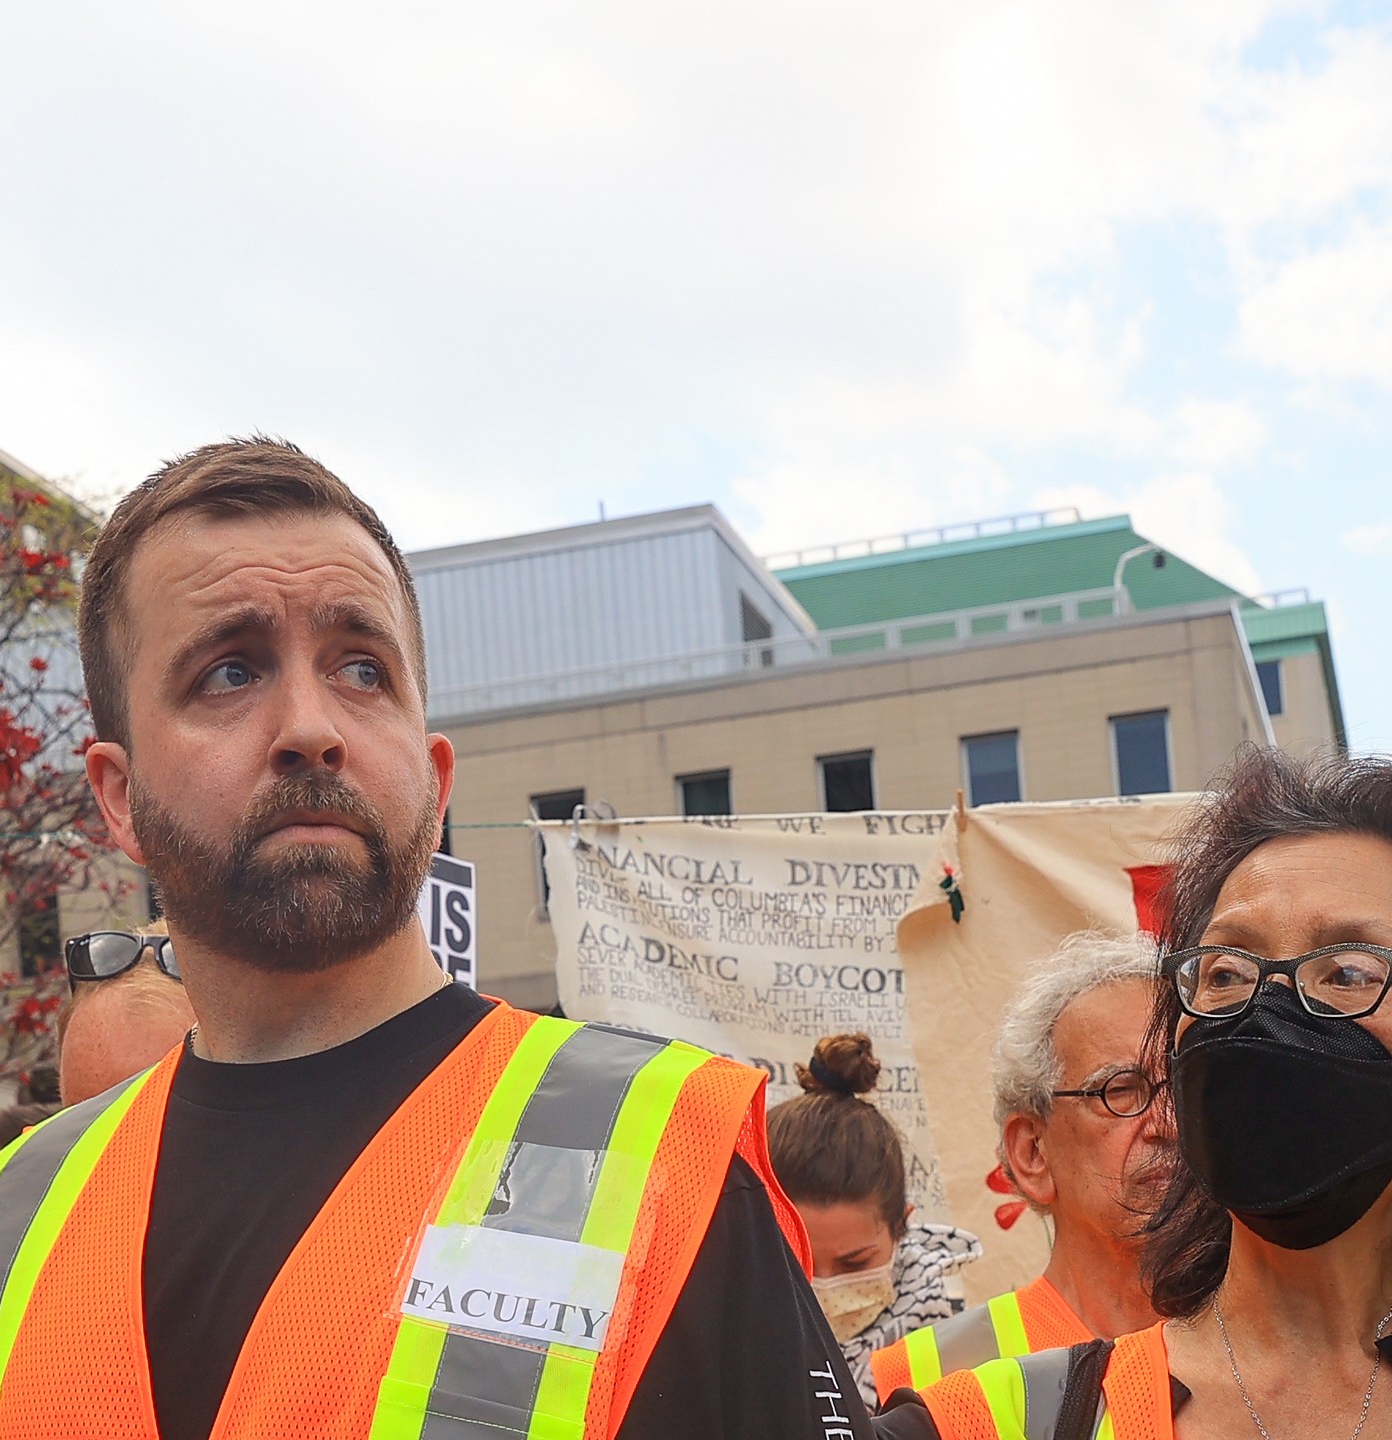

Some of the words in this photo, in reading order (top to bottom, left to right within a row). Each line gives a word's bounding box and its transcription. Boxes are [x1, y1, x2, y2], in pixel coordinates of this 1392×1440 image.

[775, 816, 826, 835] WE
[863, 813, 948, 836] FIGH
[587, 843, 752, 886] NANCIAL
[604, 882, 711, 923] INSUTIONS
[719, 909, 754, 928] THAT
[761, 911, 825, 937] PROFIT
[831, 917, 877, 938] FROM
[638, 880, 672, 902] ALL
[681, 886, 704, 906] OF
[712, 887, 827, 916] COLUMBIA'S
[659, 921, 711, 942] NSURE
[718, 927, 854, 950] ACCOUNTABILITY
[864, 936, 885, 953] BY
[578, 921, 739, 982] ACADEMIC
[773, 961, 904, 993] BOYCOT
[754, 987, 807, 1005] WITH
[816, 990, 888, 1009] ISRAELI
[773, 1008, 824, 1023] WITH
[404, 1277, 610, 1340] FACULTY
